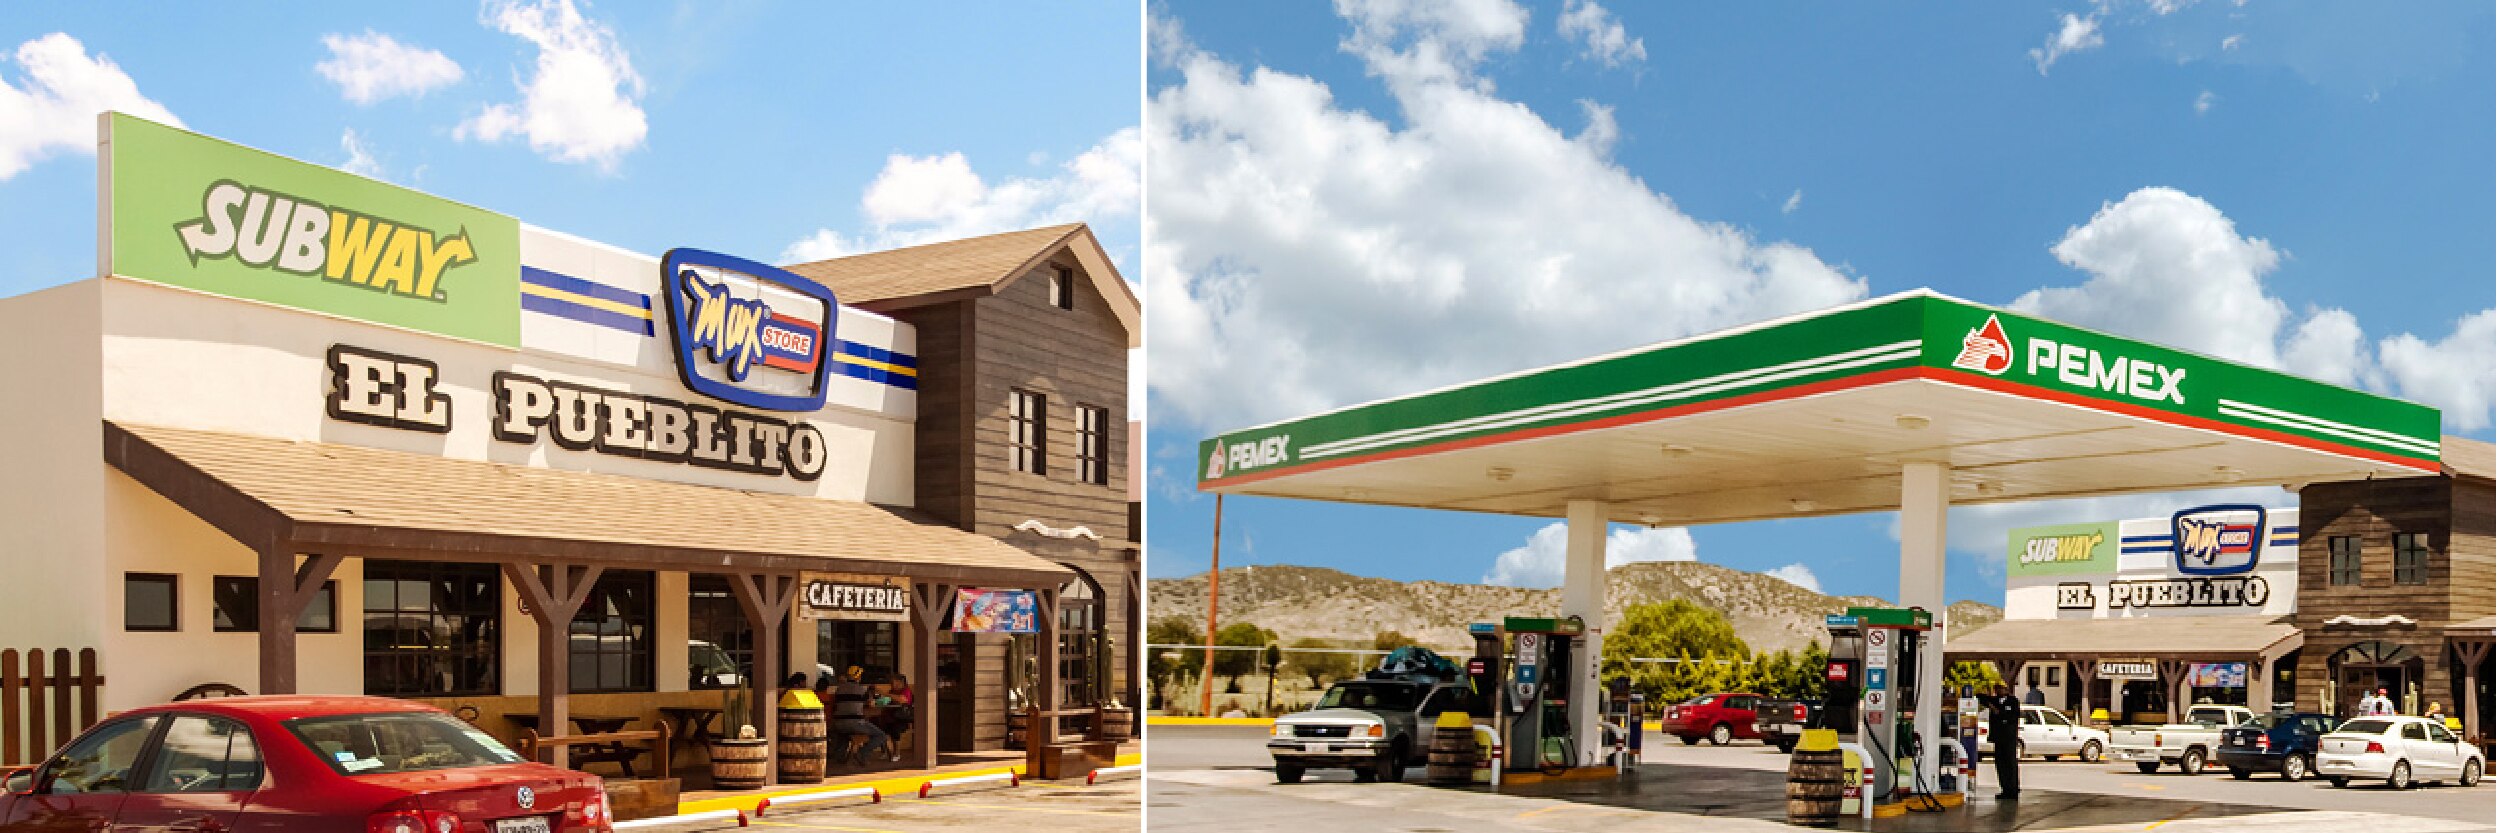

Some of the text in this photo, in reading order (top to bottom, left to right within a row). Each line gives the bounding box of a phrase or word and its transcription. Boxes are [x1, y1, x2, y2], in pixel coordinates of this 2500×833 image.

[173, 179, 477, 302] SUBWAY
[762, 325, 812, 355] STORE
[2027, 337, 2186, 405] PEMEX
[333, 347, 825, 479] EL PUEBLITO
[1228, 434, 1290, 470] PEMEX
[2019, 529, 2104, 567] SUBWAY
[2058, 577, 2269, 609] EL PUEBLITO
